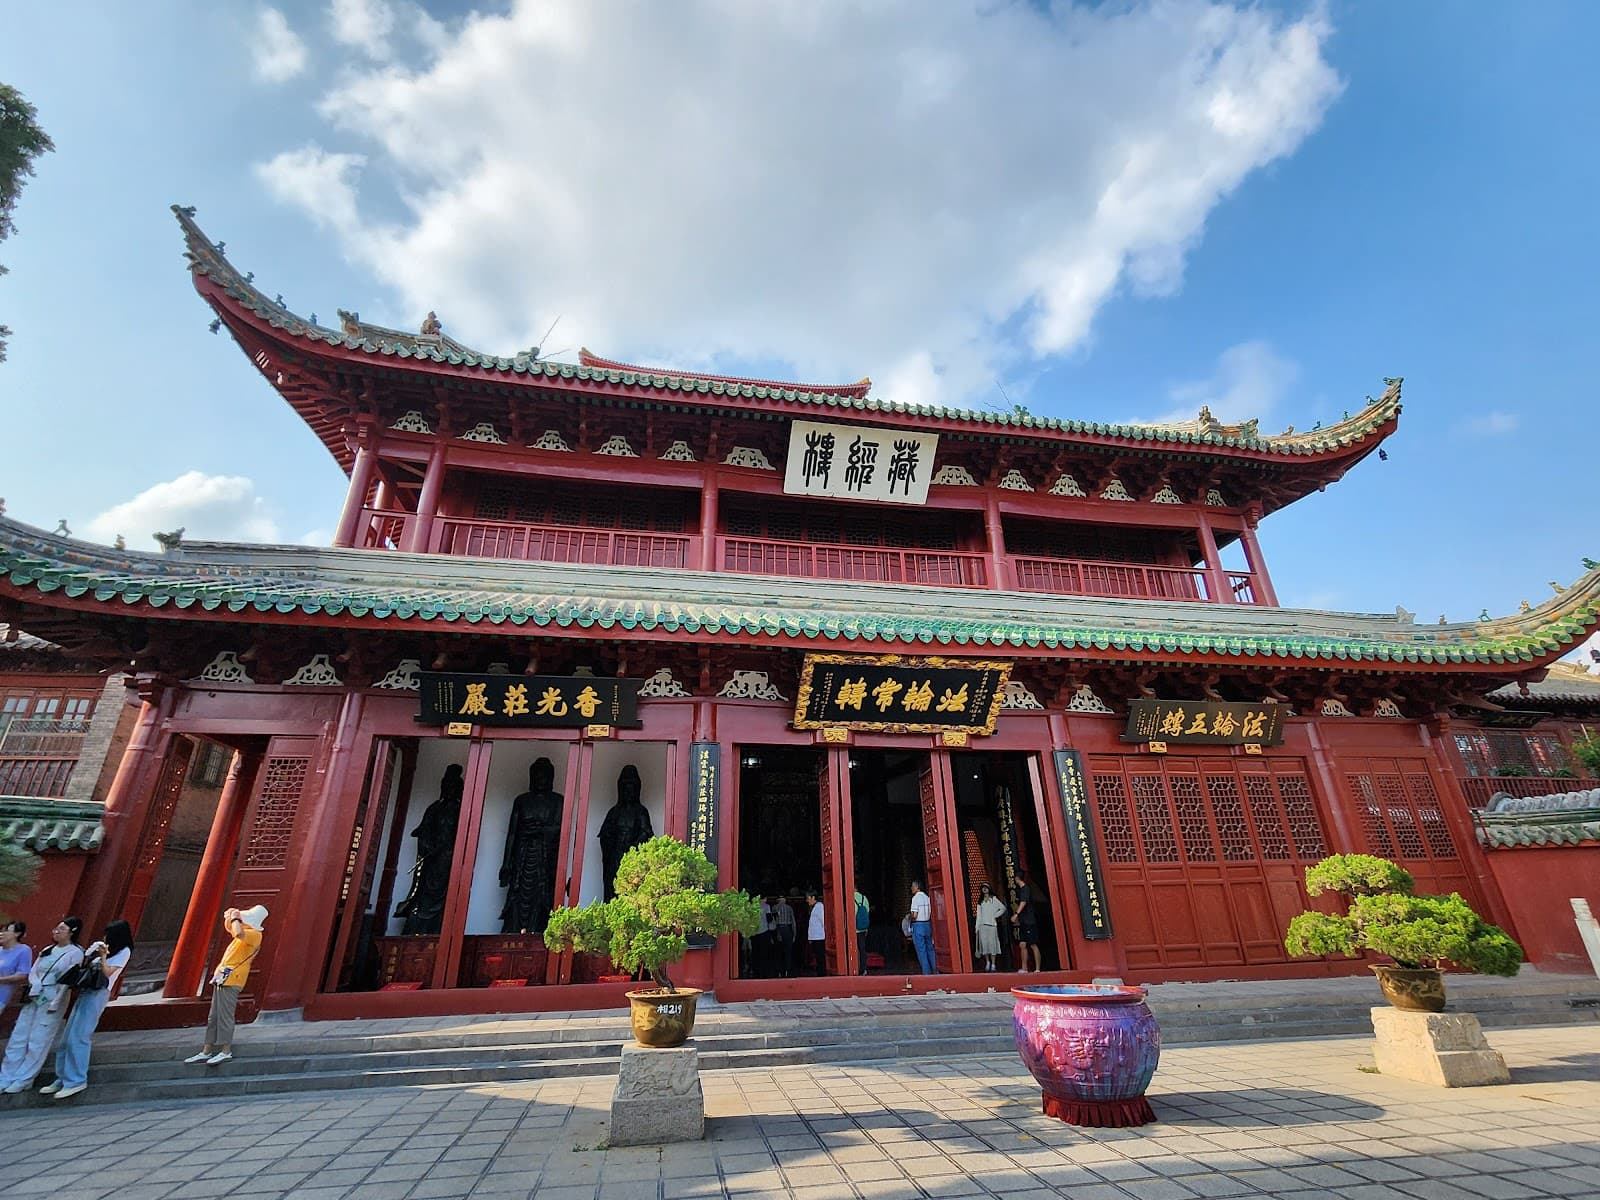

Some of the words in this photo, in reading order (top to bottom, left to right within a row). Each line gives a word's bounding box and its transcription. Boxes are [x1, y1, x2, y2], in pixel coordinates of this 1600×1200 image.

[803, 429, 921, 496] 藏經樓
[458, 682, 604, 718] 香光莊嚴
[834, 676, 969, 713] 法輪常轉
